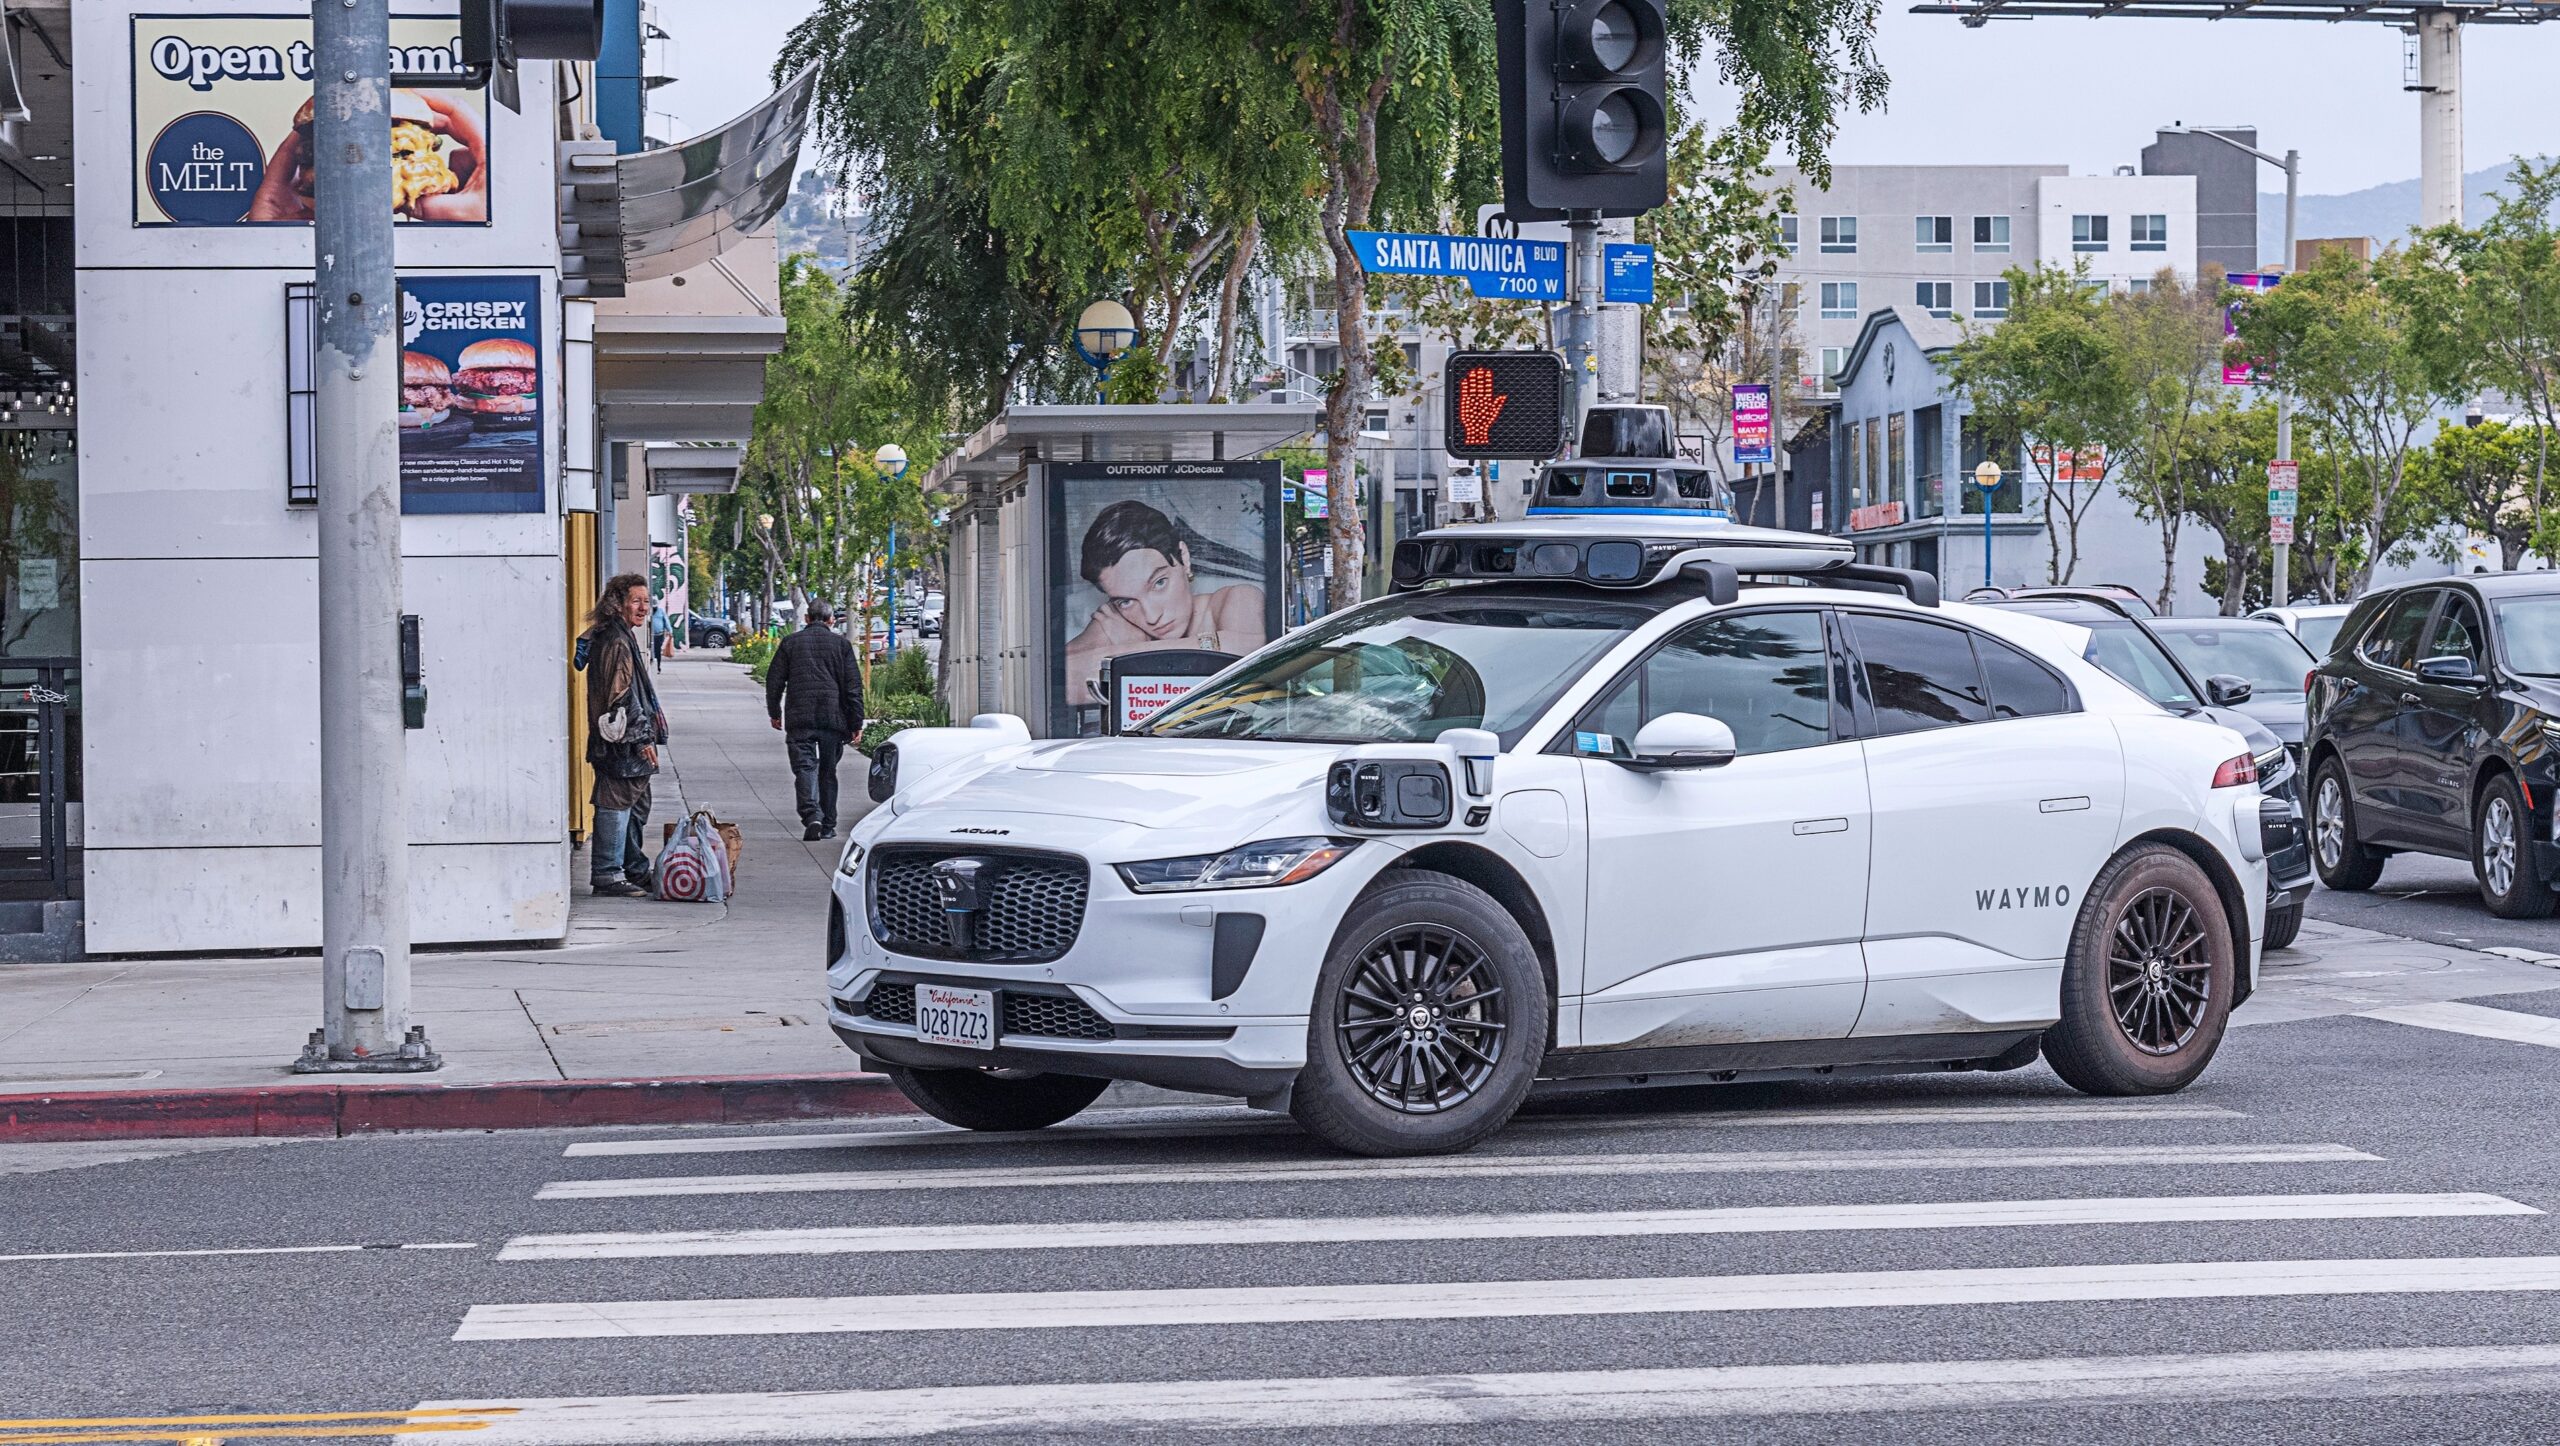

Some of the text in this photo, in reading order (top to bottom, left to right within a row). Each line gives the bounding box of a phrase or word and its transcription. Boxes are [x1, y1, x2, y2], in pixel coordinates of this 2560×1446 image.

[152, 37, 464, 88] Open t am!
[192, 143, 224, 160] the
[160, 163, 253, 191] MELT
[1376, 238, 1558, 273] SANTA MONICA BLVD
[1499, 277, 1558, 293] 7100 W
[425, 302, 526, 317] CRISPY
[426, 317, 526, 330] CHICKEN
[1735, 393, 1768, 401] WEHO
[1736, 401, 1768, 409] PRIDE
[1679, 448, 1701, 457] DOG
[1106, 465, 1169, 474] OUTFRONT
[1174, 464, 1224, 474] JCDecaux
[1128, 683, 1158, 694] Local
[1975, 884, 2070, 911] WAYMO
[931, 989, 978, 1008] California
[935, 1036, 975, 1045] dmv.ca.gov
